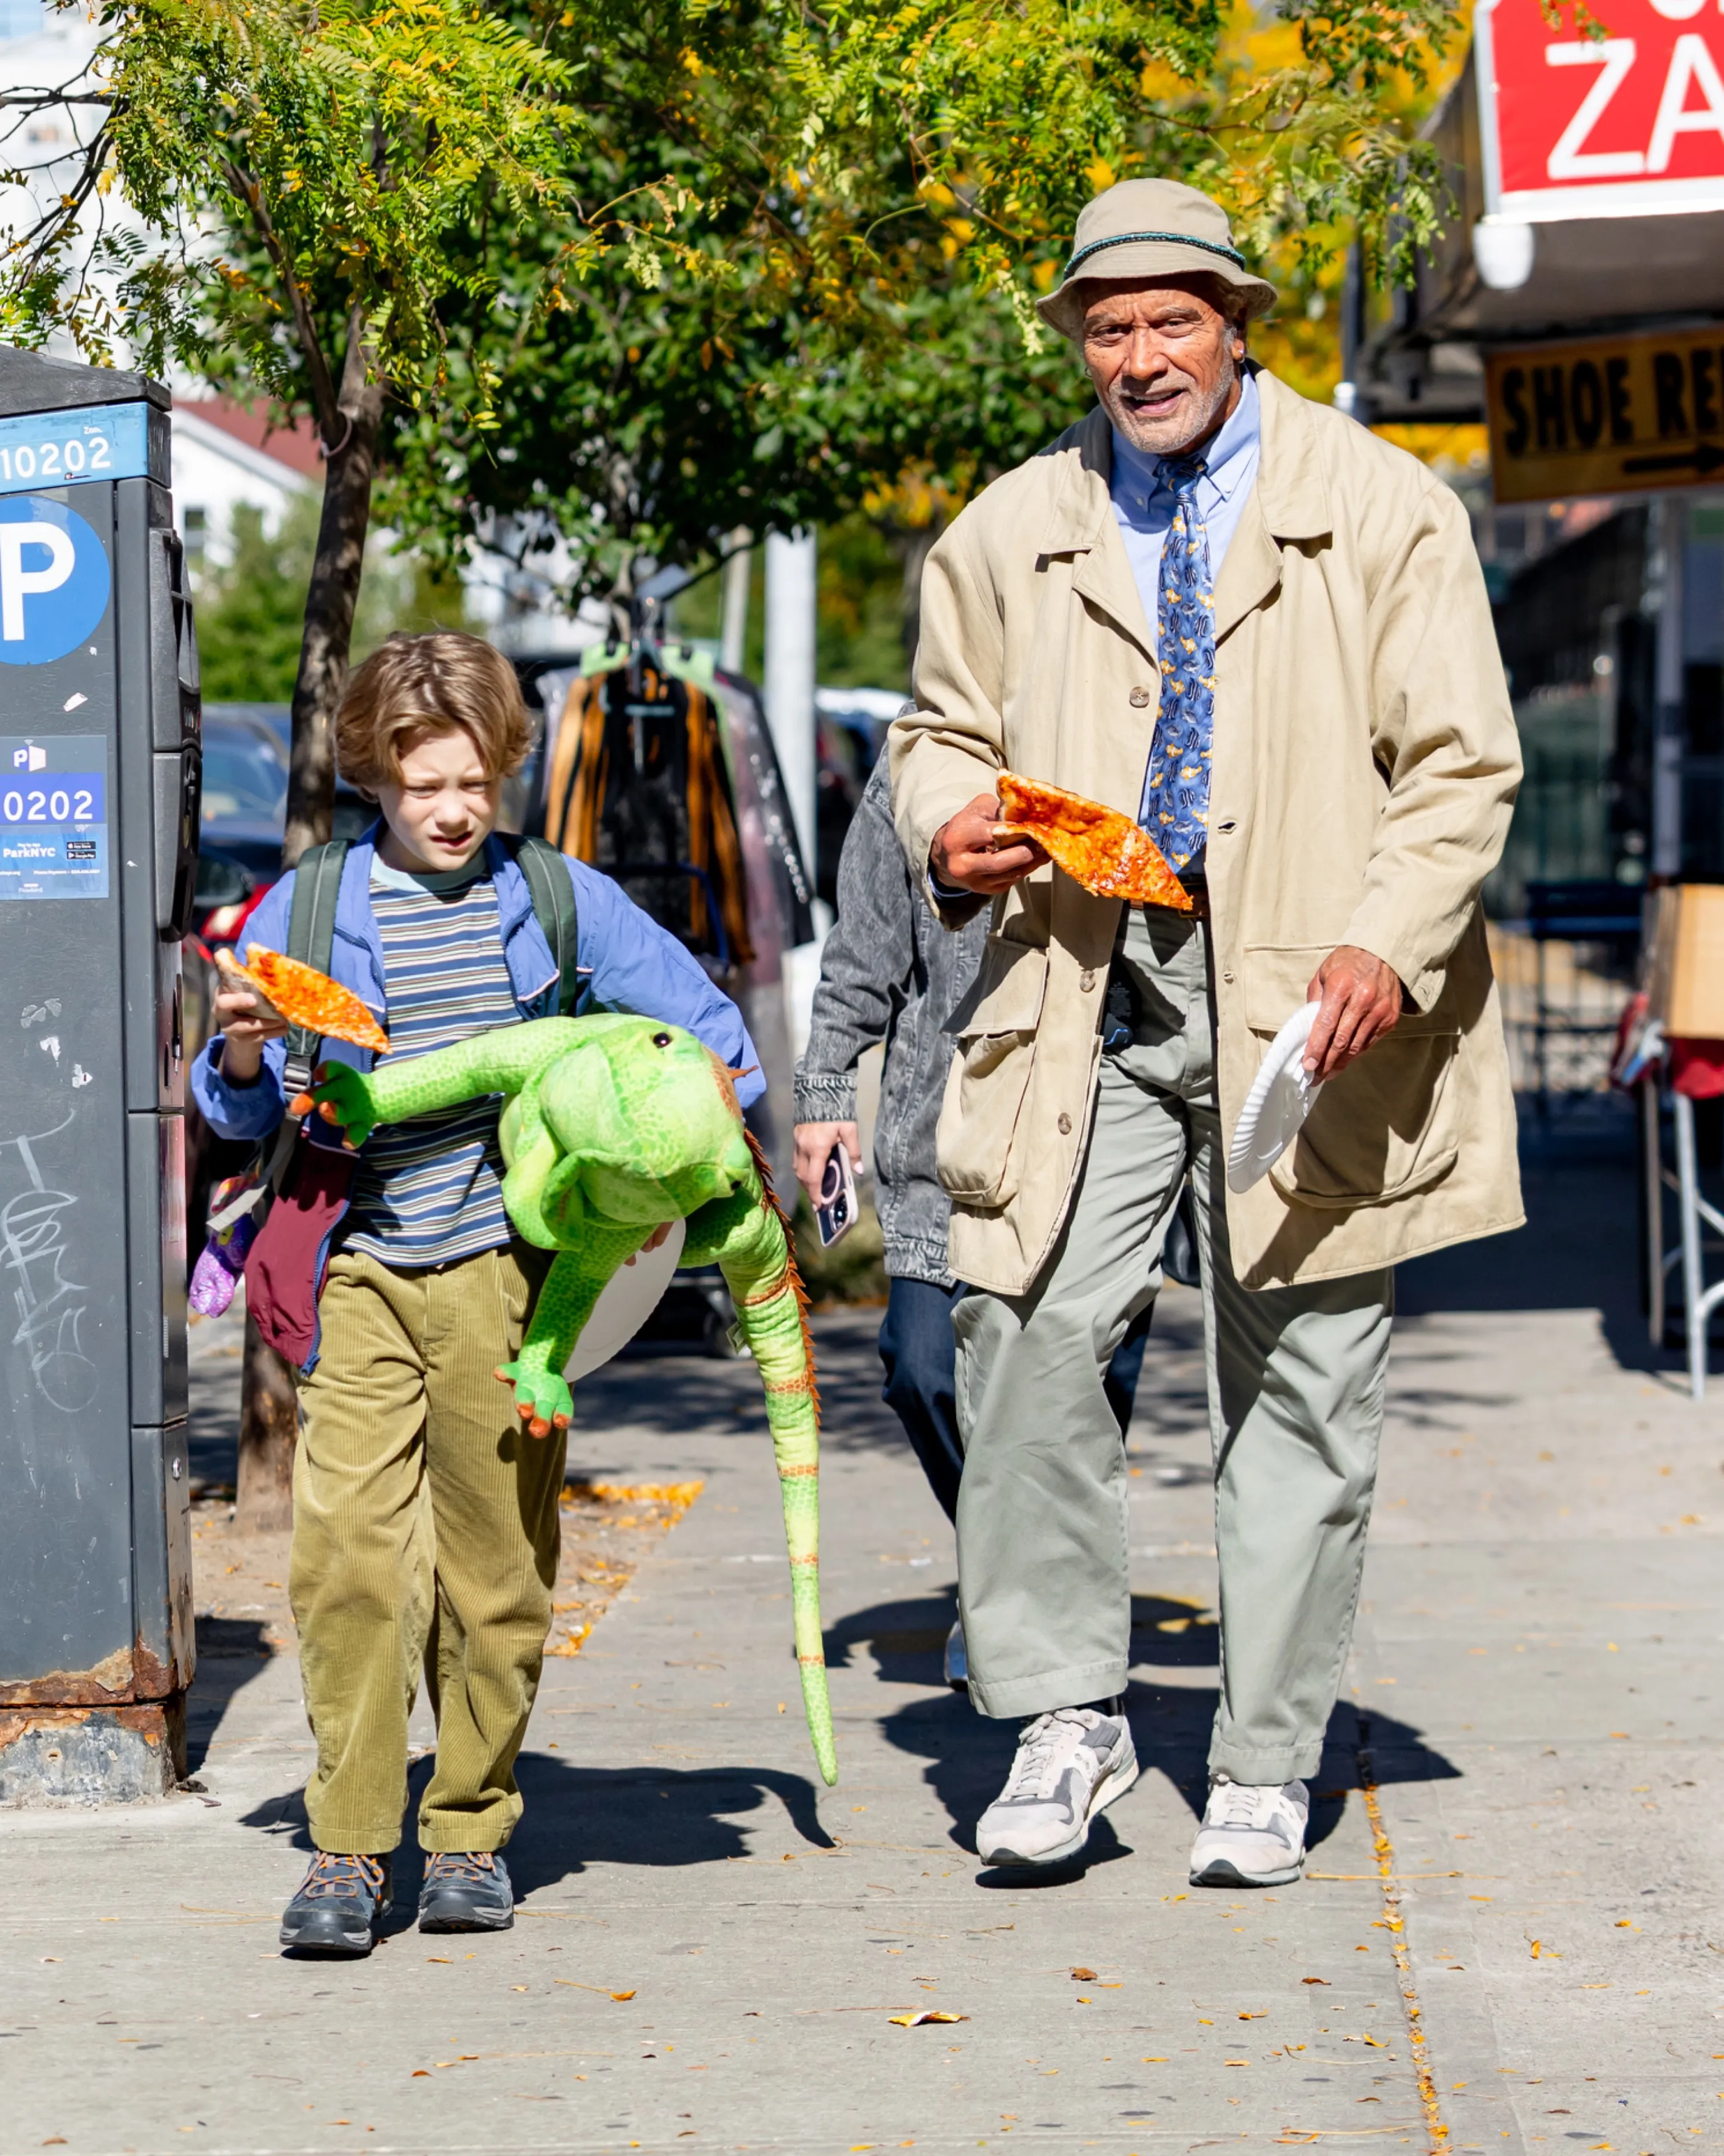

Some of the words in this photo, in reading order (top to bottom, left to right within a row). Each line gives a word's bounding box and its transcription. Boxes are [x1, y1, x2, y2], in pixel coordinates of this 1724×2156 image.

[1502, 356, 1635, 460] SHOE
[1654, 344, 1724, 437] RE
[0, 437, 111, 479] 10202
[0, 521, 75, 641] P
[3, 790, 93, 821] 0202
[3, 848, 56, 857] ParkNYC
